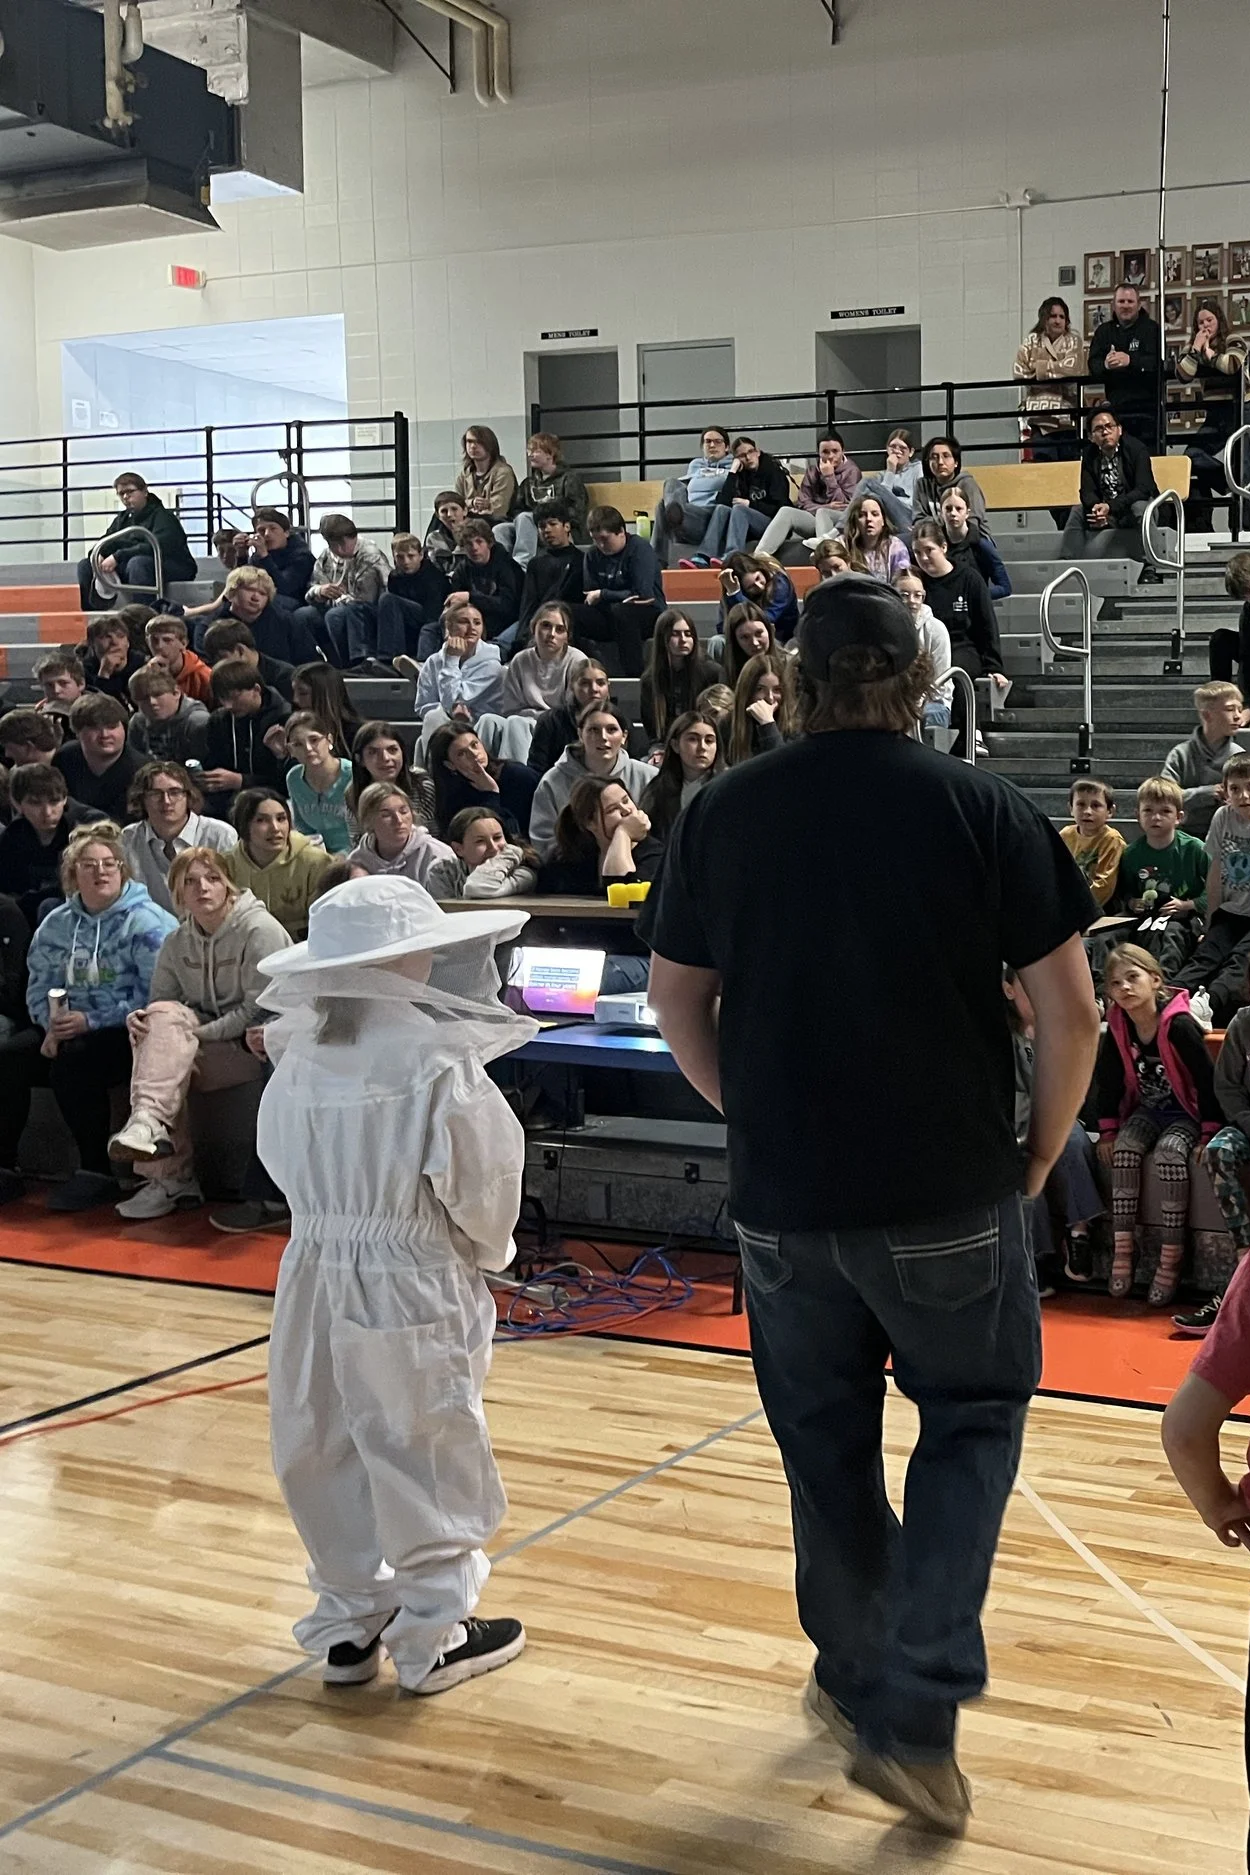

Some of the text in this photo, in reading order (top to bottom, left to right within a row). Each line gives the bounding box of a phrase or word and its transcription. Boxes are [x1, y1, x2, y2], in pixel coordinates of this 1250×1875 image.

[838, 307, 897, 318] WOMENS TOILET
[568, 330, 591, 338] TOILET
